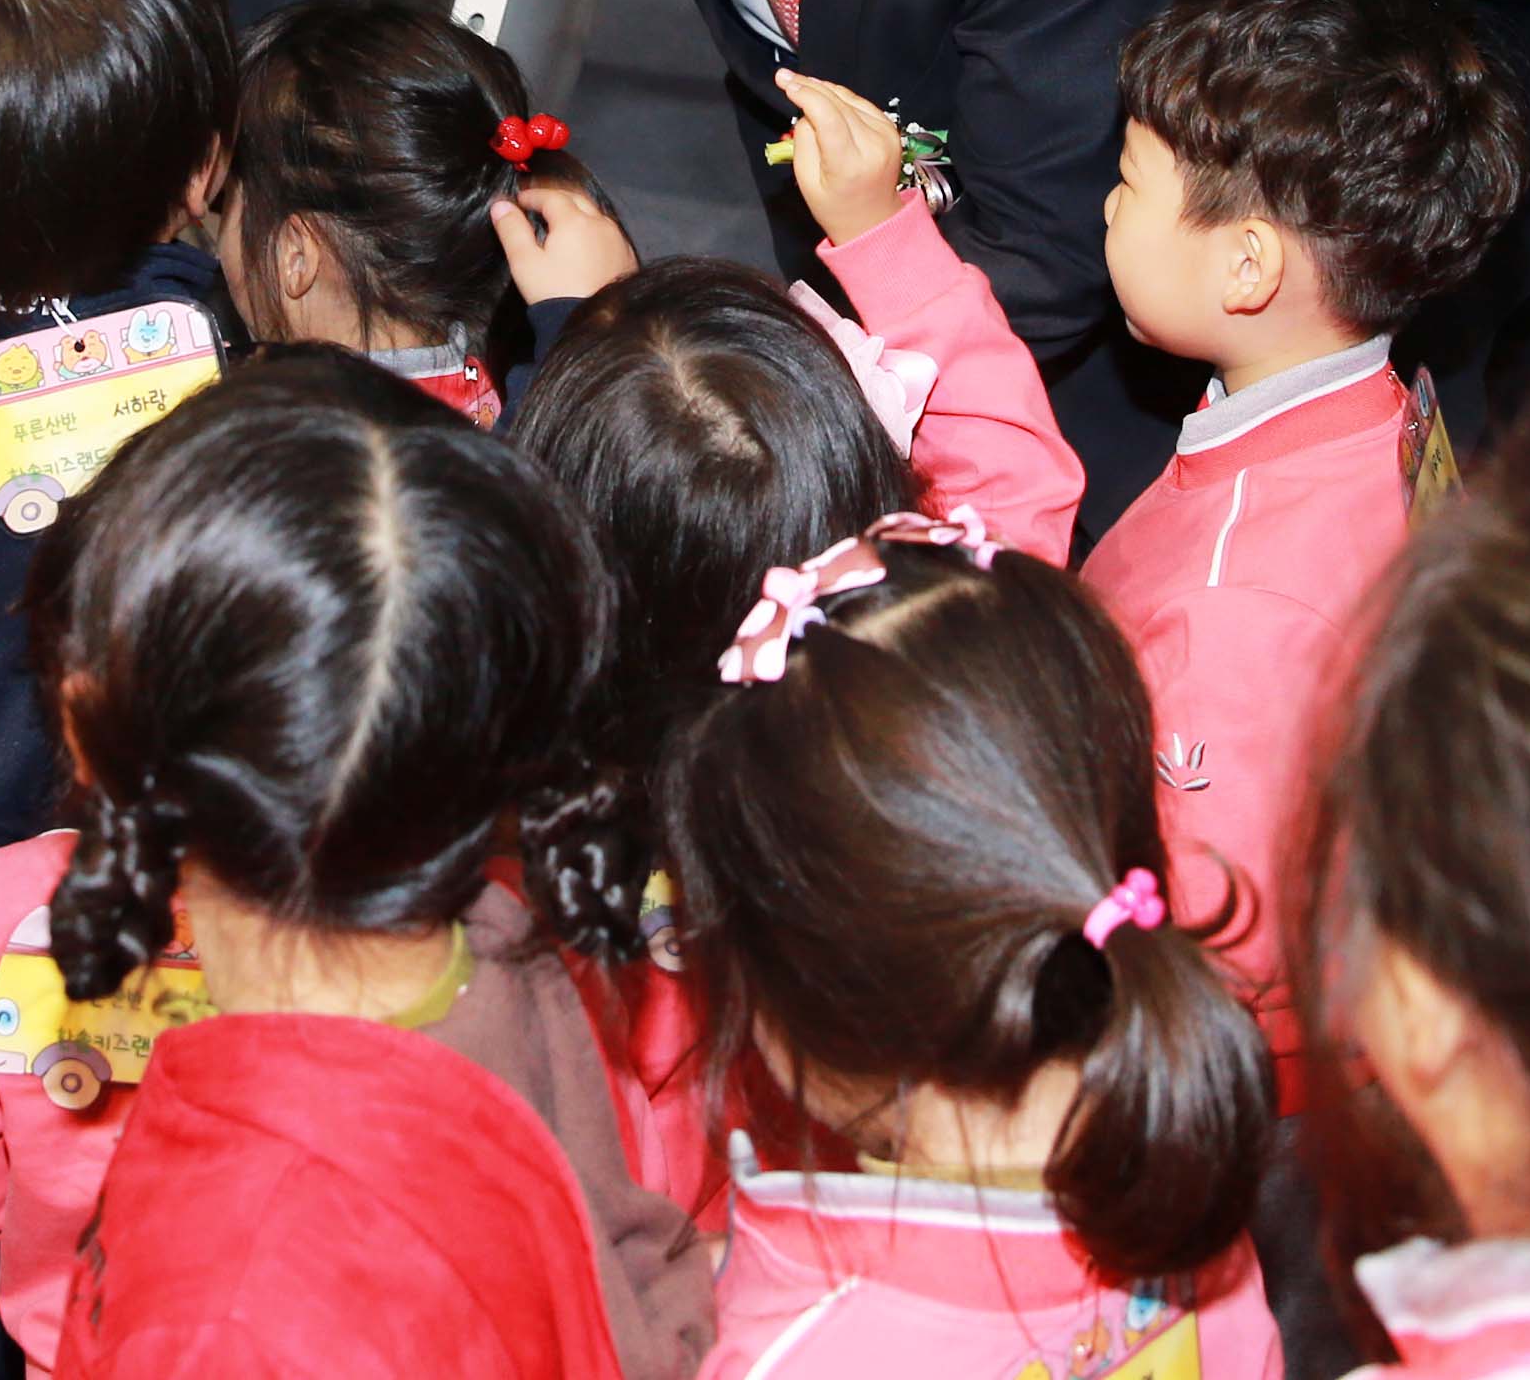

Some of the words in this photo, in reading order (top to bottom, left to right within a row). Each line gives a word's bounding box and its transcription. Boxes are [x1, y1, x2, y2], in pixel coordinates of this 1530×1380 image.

[13, 411, 78, 443] 푸른산반
[113, 388, 168, 417] 서하랑
[57, 1028, 151, 1057] 한솔키즈랜
